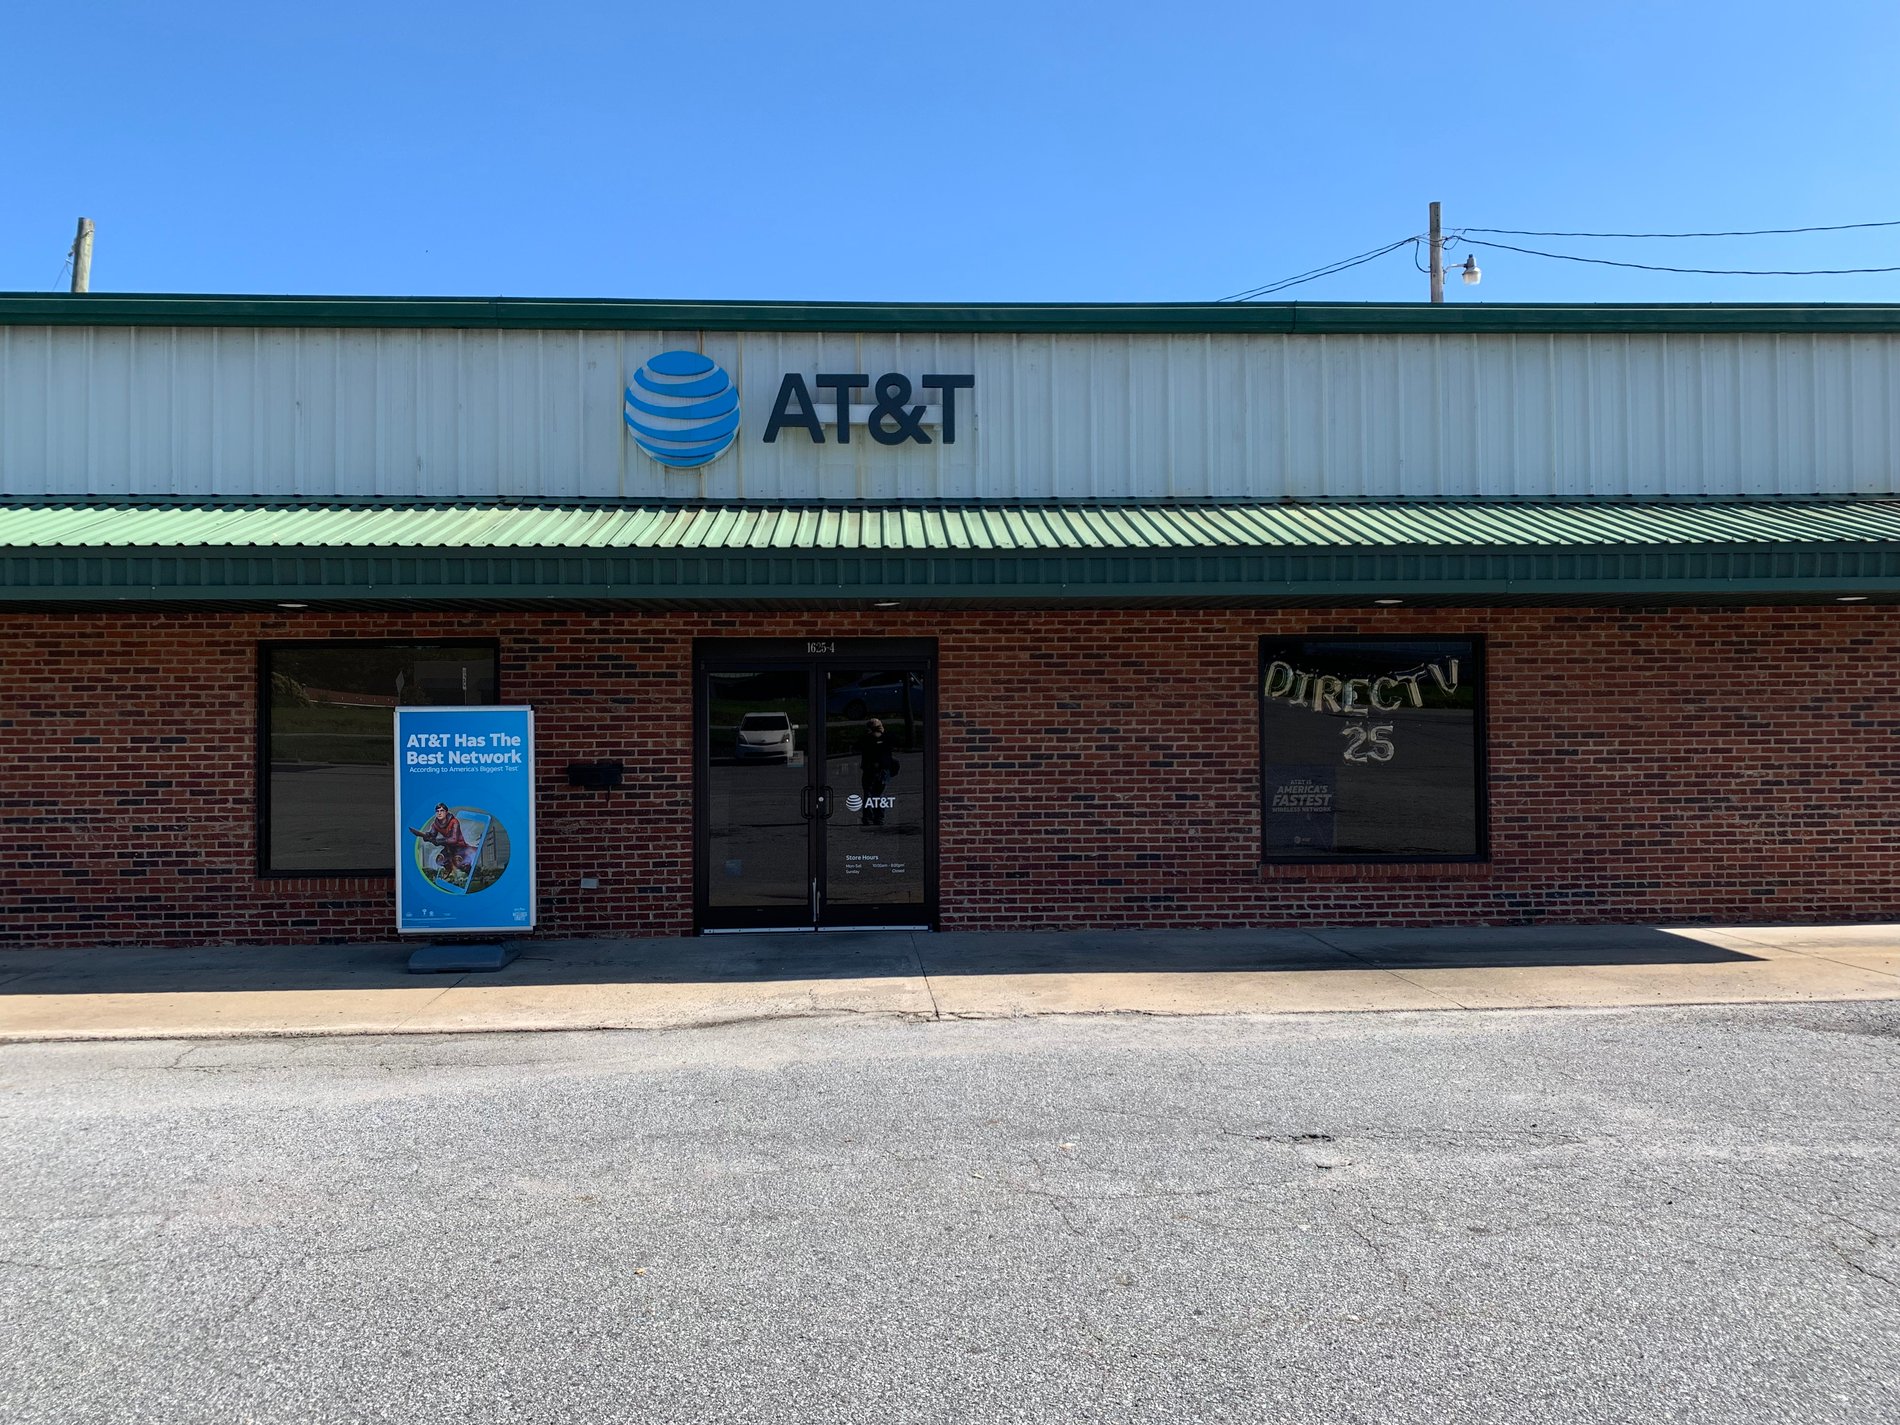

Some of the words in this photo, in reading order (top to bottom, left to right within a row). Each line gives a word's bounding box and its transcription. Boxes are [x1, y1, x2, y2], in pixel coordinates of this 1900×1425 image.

[762, 372, 975, 445] AT&T
[807, 642, 835, 653] 1625-4
[1264, 658, 1460, 714] DIRECTV
[406, 733, 451, 748] AT&T
[454, 733, 486, 747] Has
[489, 732, 521, 747] The
[1341, 724, 1395, 763] 25
[406, 751, 444, 765] Best
[448, 749, 522, 764] Network
[409, 766, 440, 774] According
[479, 765, 503, 773] Biggest
[1276, 785, 1328, 794] AMERICA'S
[864, 797, 895, 808] AT&T
[1272, 793, 1332, 806] FASTEST
